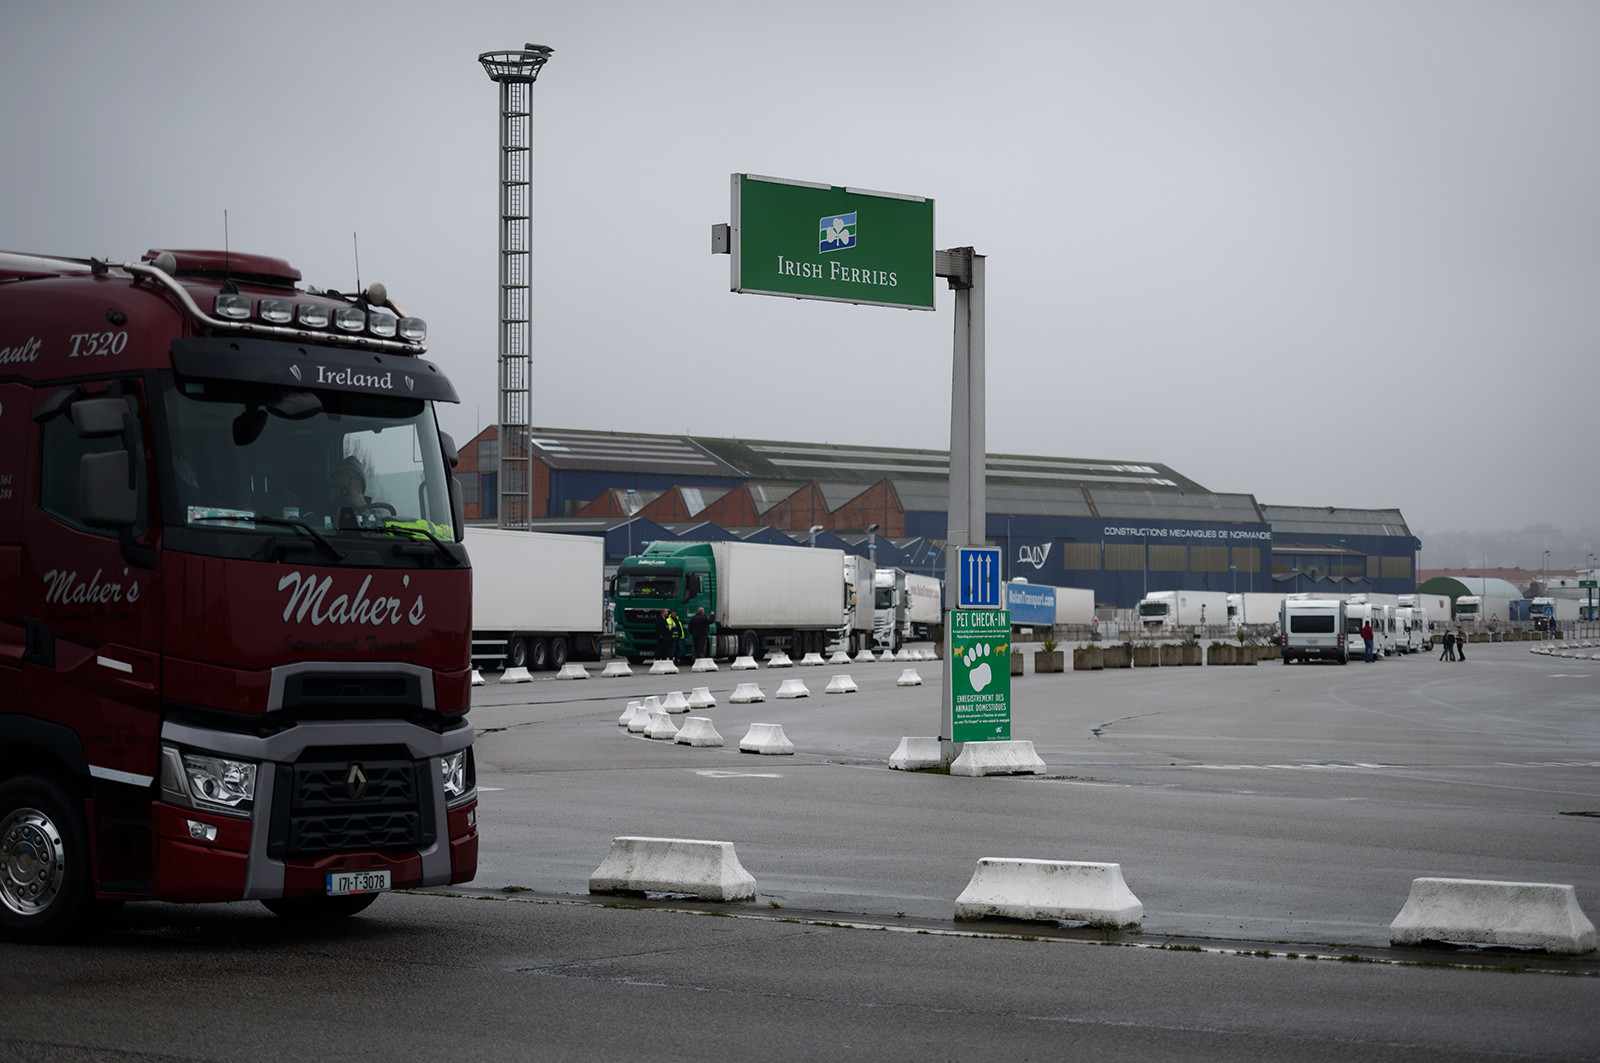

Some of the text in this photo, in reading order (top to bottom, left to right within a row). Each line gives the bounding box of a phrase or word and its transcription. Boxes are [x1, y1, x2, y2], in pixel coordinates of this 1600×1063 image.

[69, 331, 129, 358] T520
[316, 365, 394, 389] Ireland
[1103, 526, 1272, 540] CONSTRUCTIONS MECANIQUES DE NORMANDIE
[1017, 542, 1052, 569] CMN
[43, 567, 140, 605] Maher's
[277, 571, 426, 626] Maher's
[956, 612, 1006, 627] PET CHECK-IN
[955, 704, 974, 712] ANIMAUX
[957, 693, 1005, 703] ENREGISTREMENT DES
[339, 874, 385, 892] 171-T-3078
